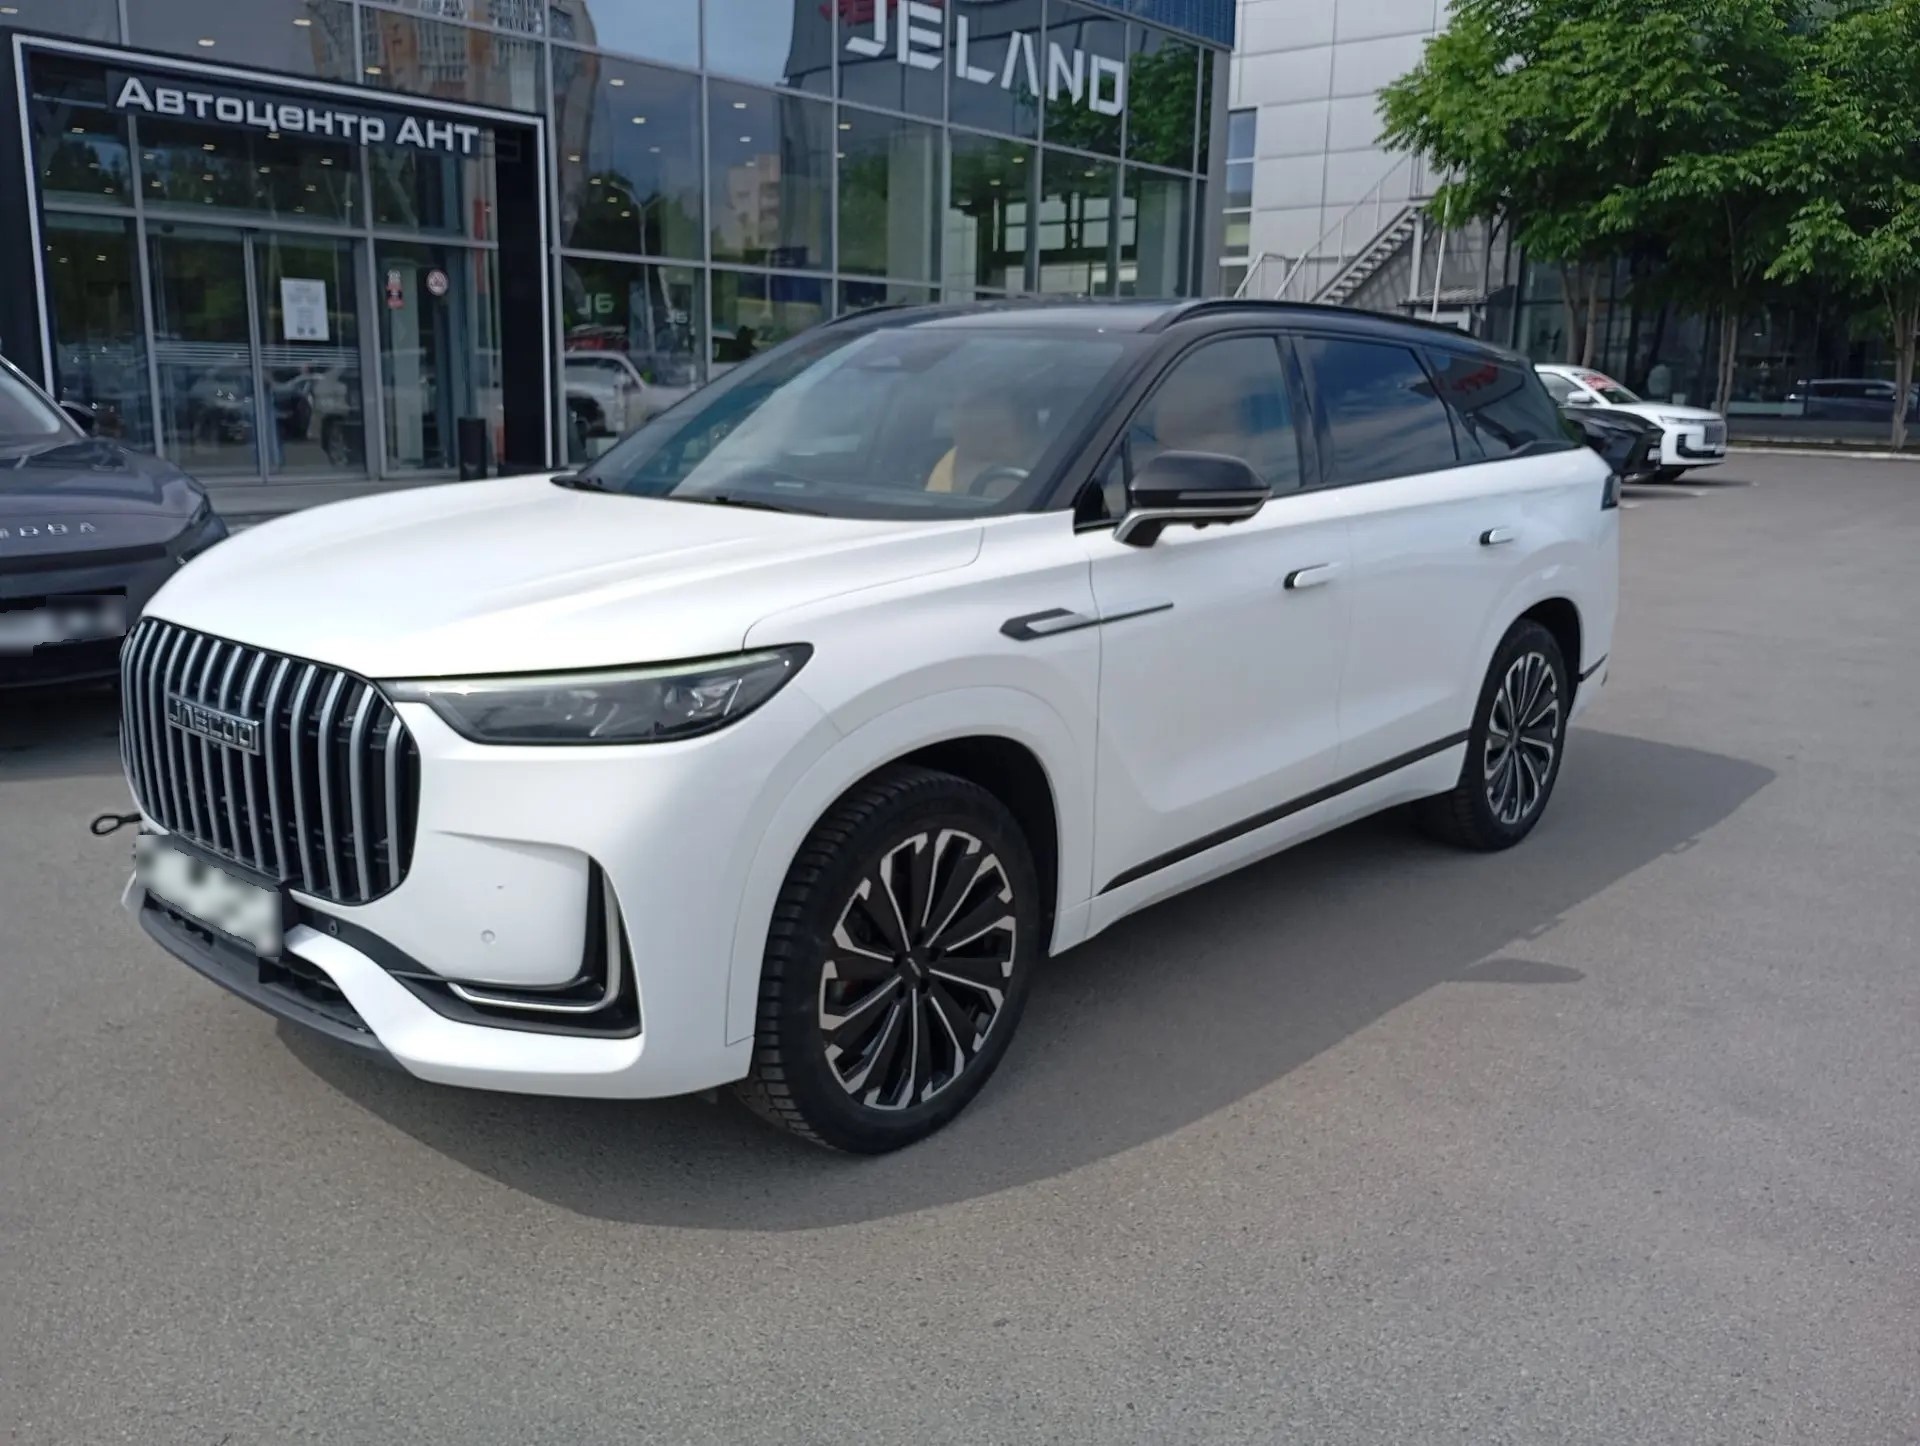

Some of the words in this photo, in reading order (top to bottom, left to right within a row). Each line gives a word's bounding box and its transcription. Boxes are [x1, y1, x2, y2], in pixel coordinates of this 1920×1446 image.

[845, 0, 1124, 116] JELAND
[116, 76, 386, 147] Автоцентр
[395, 115, 480, 154] АНТ
